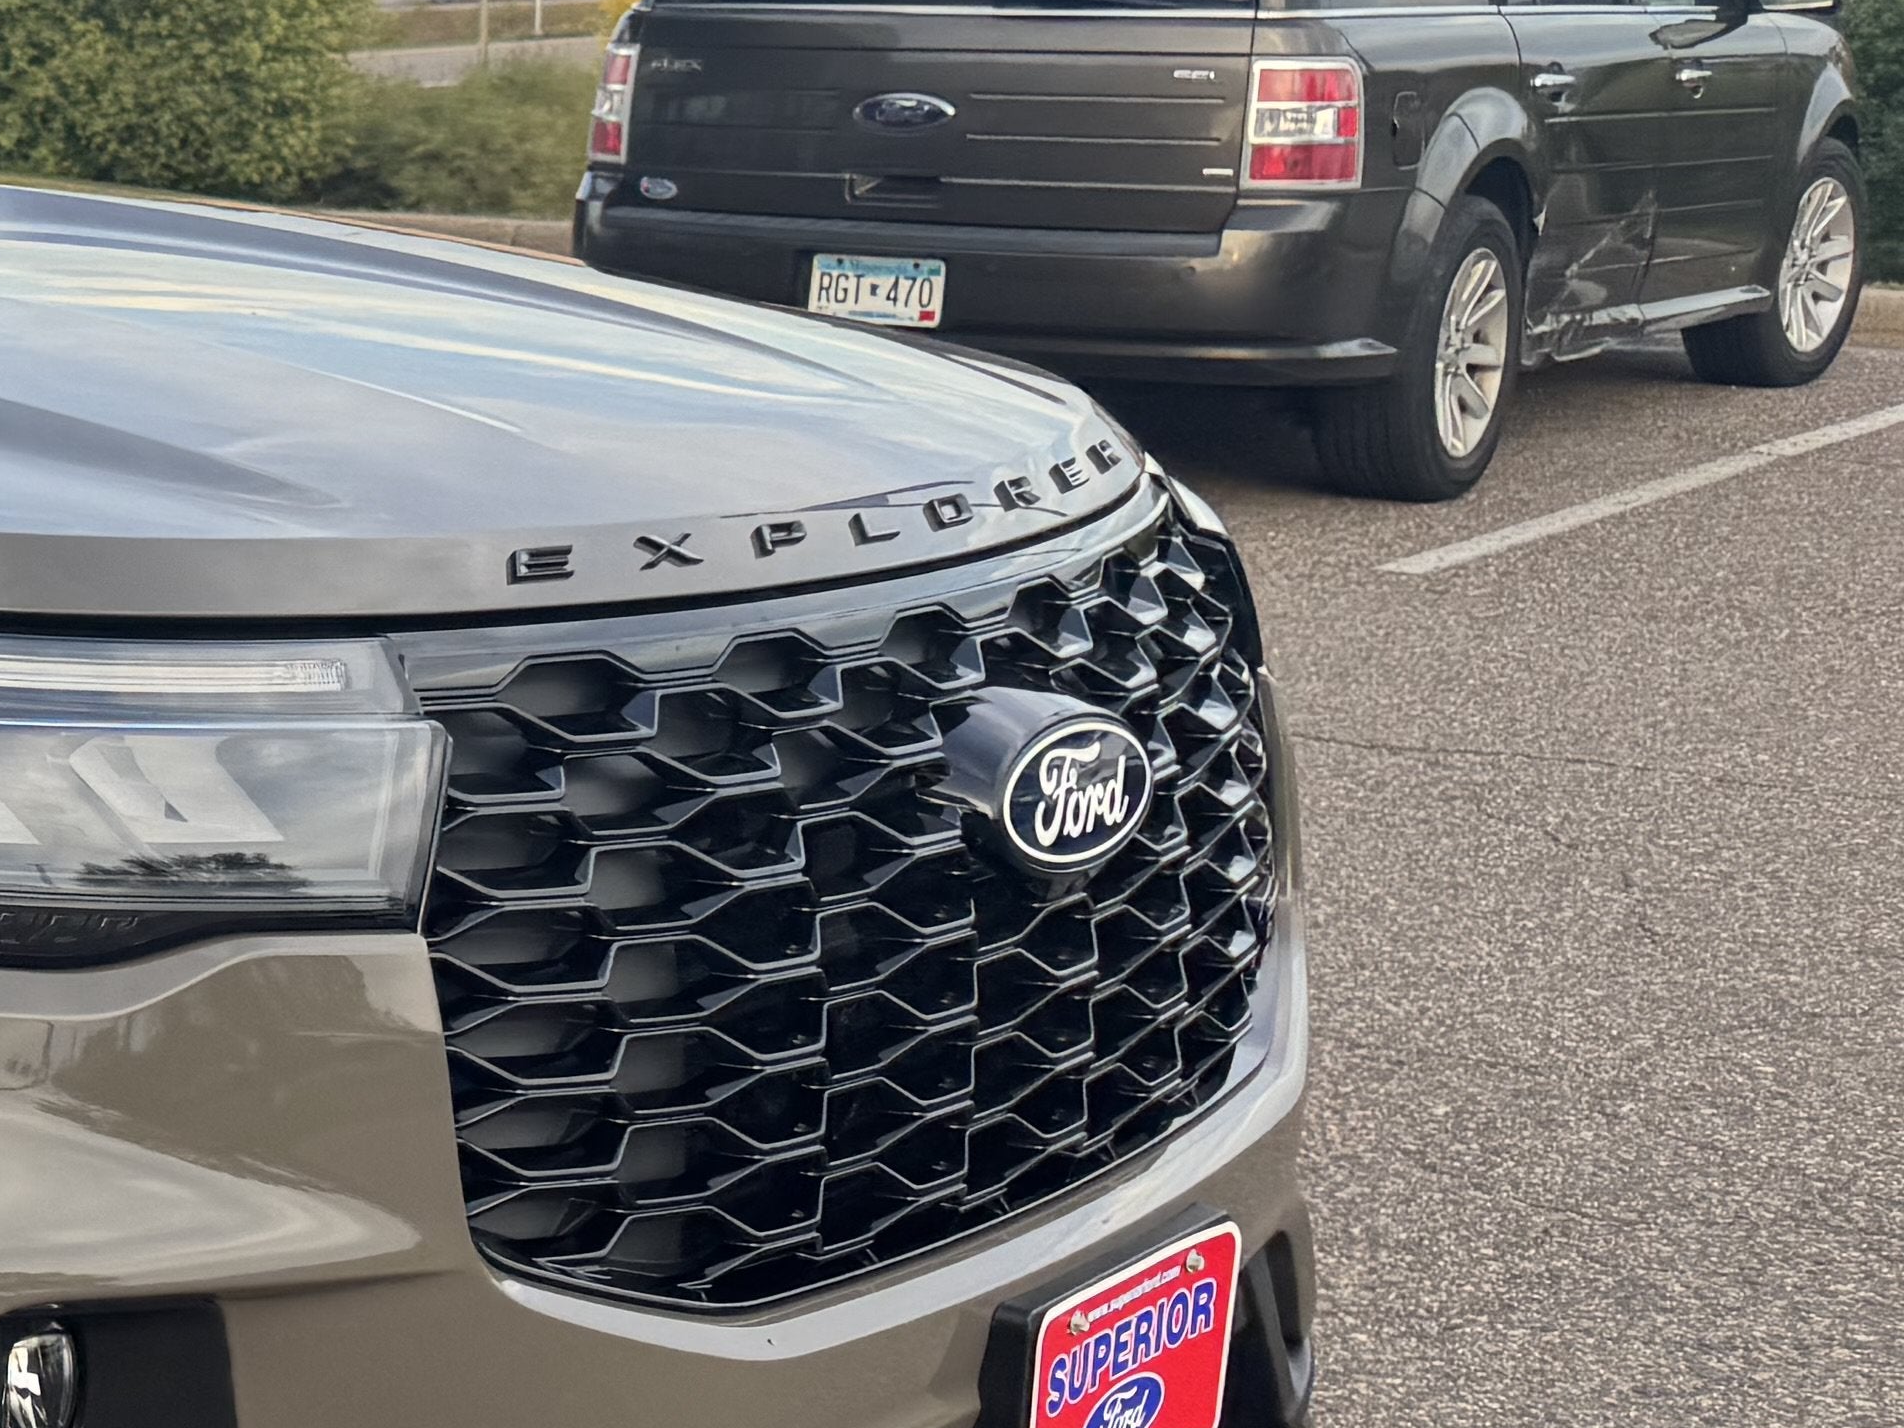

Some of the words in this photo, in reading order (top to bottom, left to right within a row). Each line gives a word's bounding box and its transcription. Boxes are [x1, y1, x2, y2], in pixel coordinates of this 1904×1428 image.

[817, 271, 865, 306] RGT
[885, 275, 933, 309] 470
[506, 438, 1122, 584] EXPLORER
[1034, 741, 1130, 847] Ford
[1045, 1277, 1218, 1419] SUPERIOR
